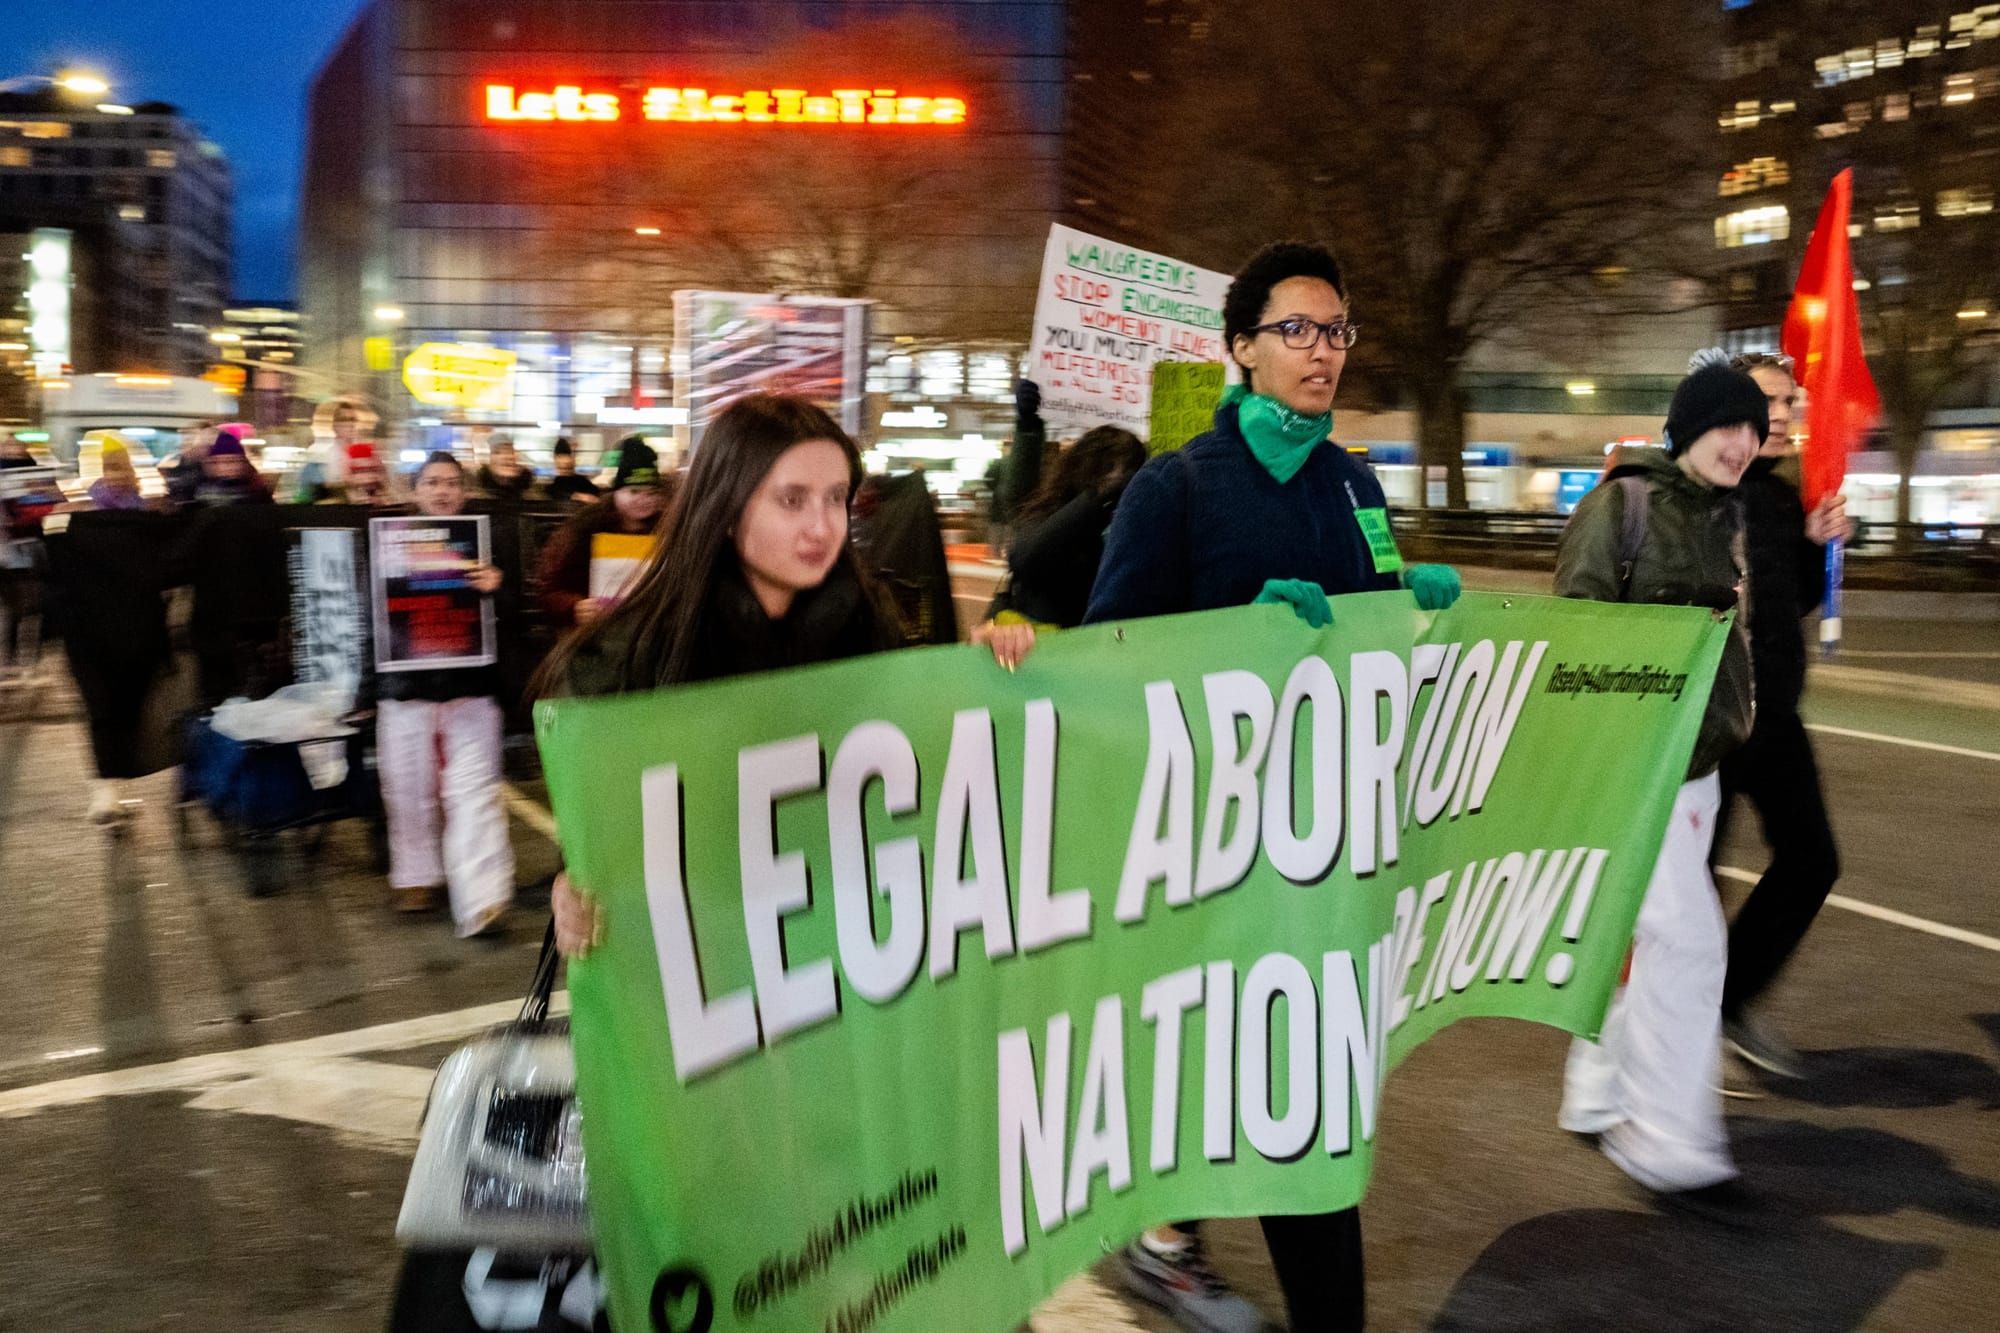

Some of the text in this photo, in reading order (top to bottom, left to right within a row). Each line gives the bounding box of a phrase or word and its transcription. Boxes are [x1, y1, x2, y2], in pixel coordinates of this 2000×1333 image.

[485, 84, 619, 121] Lets
[1054, 272, 1112, 301] STOP
[1066, 242, 1197, 290] WALGREENS
[1045, 325, 1083, 352] YOU
[1094, 335, 1149, 361] MUST
[641, 638, 1549, 1086] LEGAL ABORTION
[1414, 847, 1610, 1011] NOW!
